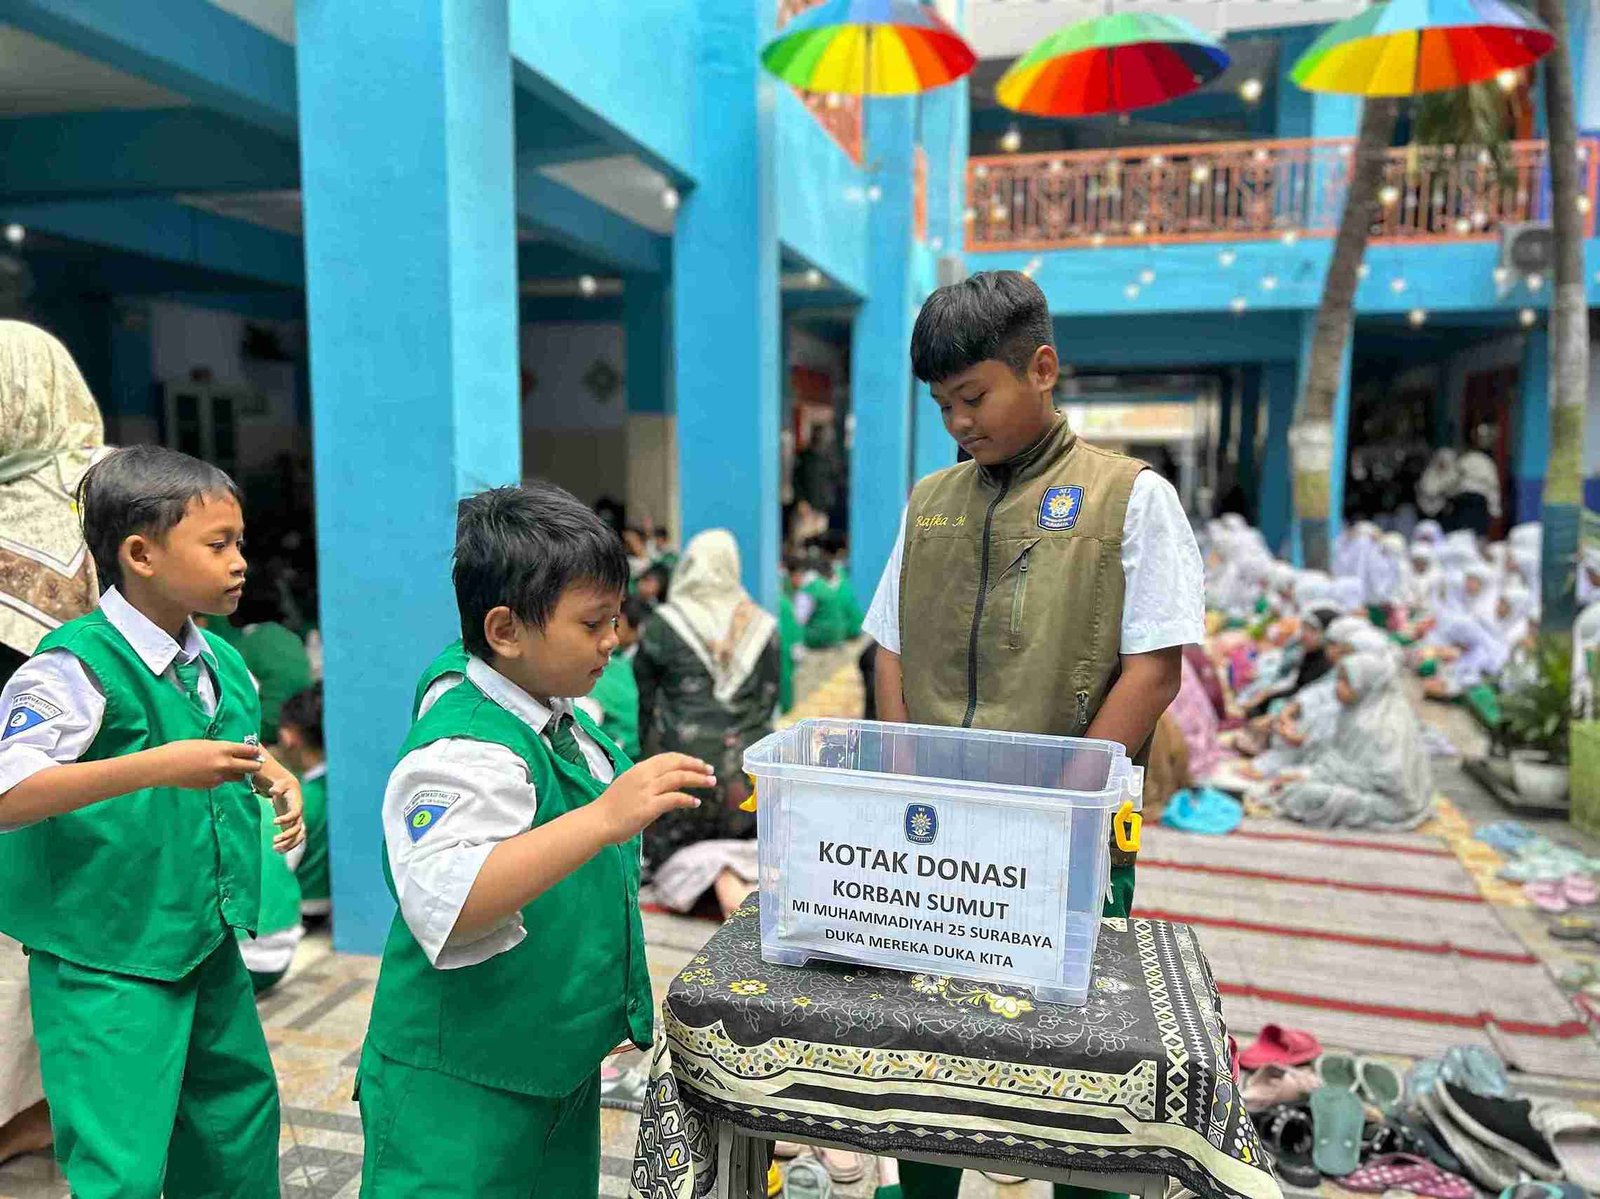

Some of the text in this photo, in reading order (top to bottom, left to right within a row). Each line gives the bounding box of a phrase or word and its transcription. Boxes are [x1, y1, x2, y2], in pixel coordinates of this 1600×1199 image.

[915, 513, 948, 531] Rafka
[12, 714, 22, 725] 2
[417, 813, 426, 825] 2
[819, 840, 1027, 890] KOTAK DONASI
[832, 879, 1010, 920] KORBAN SUMUT
[792, 899, 1053, 949] MI MUHAMMADIYAH 25 SURABAYA
[825, 928, 1014, 968] DUKA MEREKA DUKA KITA
